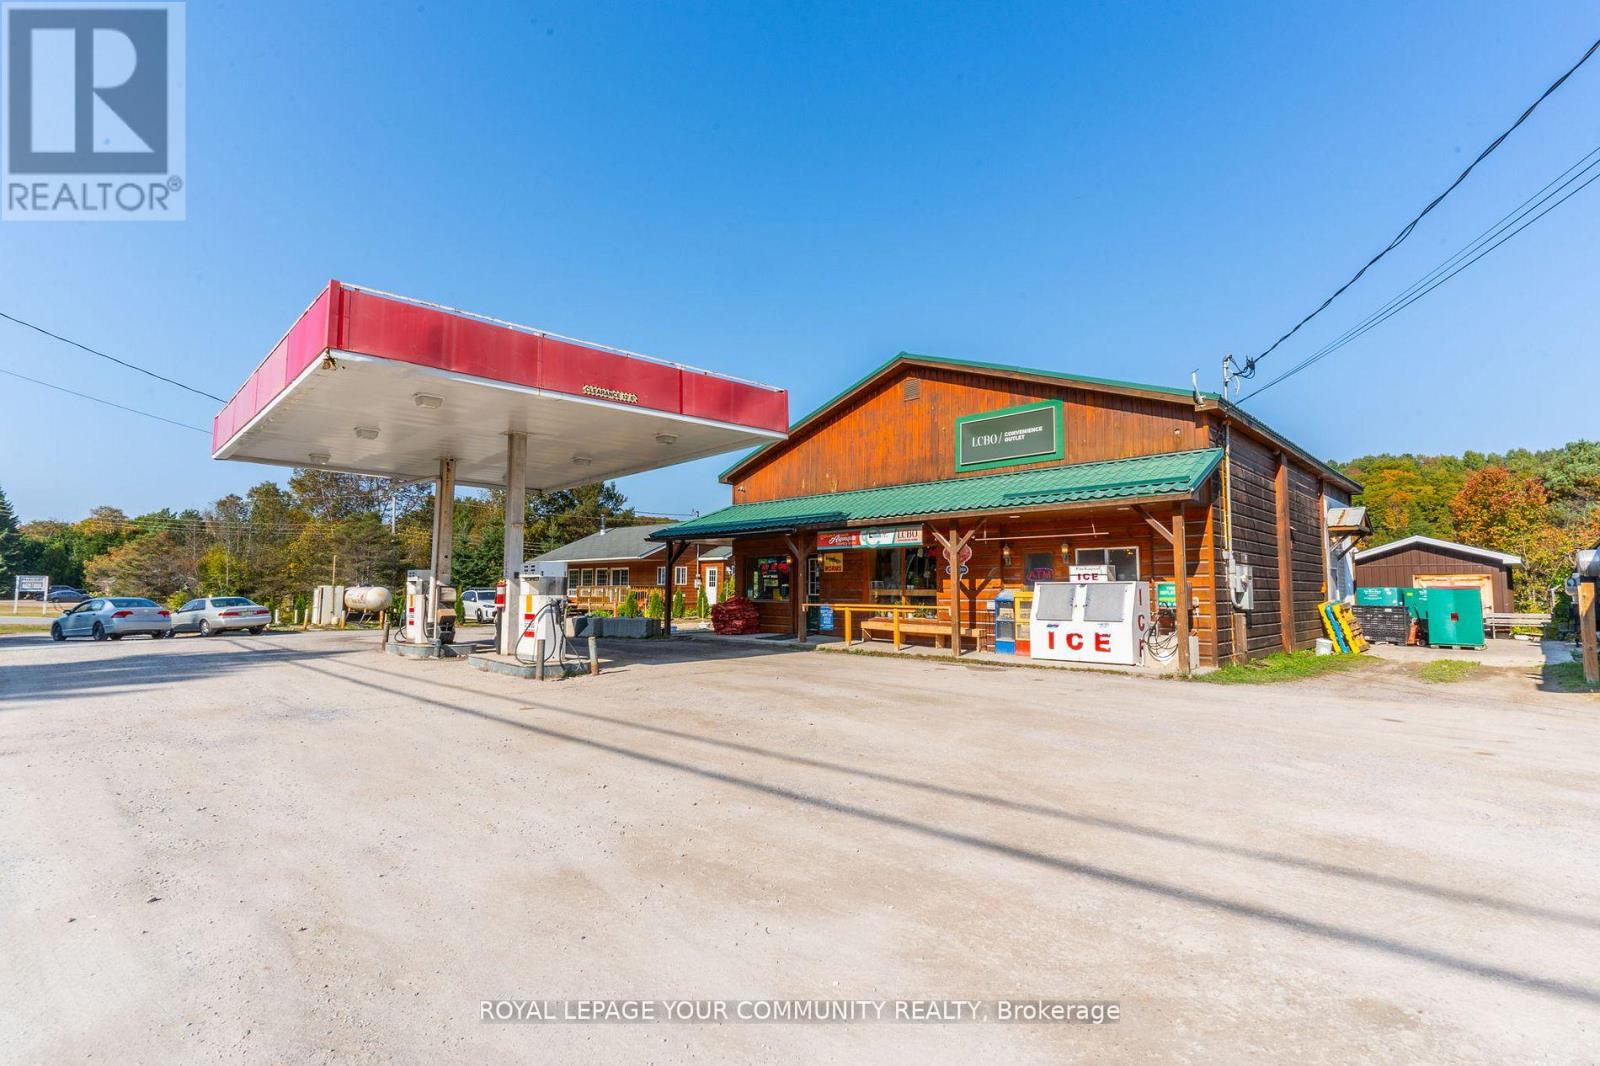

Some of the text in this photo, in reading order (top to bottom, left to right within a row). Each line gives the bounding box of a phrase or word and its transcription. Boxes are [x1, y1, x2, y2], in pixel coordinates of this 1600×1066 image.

[1004, 425, 1043, 437] CONVENIENCE
[1004, 434, 1026, 442] OUTLET
[1077, 573, 1099, 581] ICE
[1048, 631, 1111, 653] ICE
